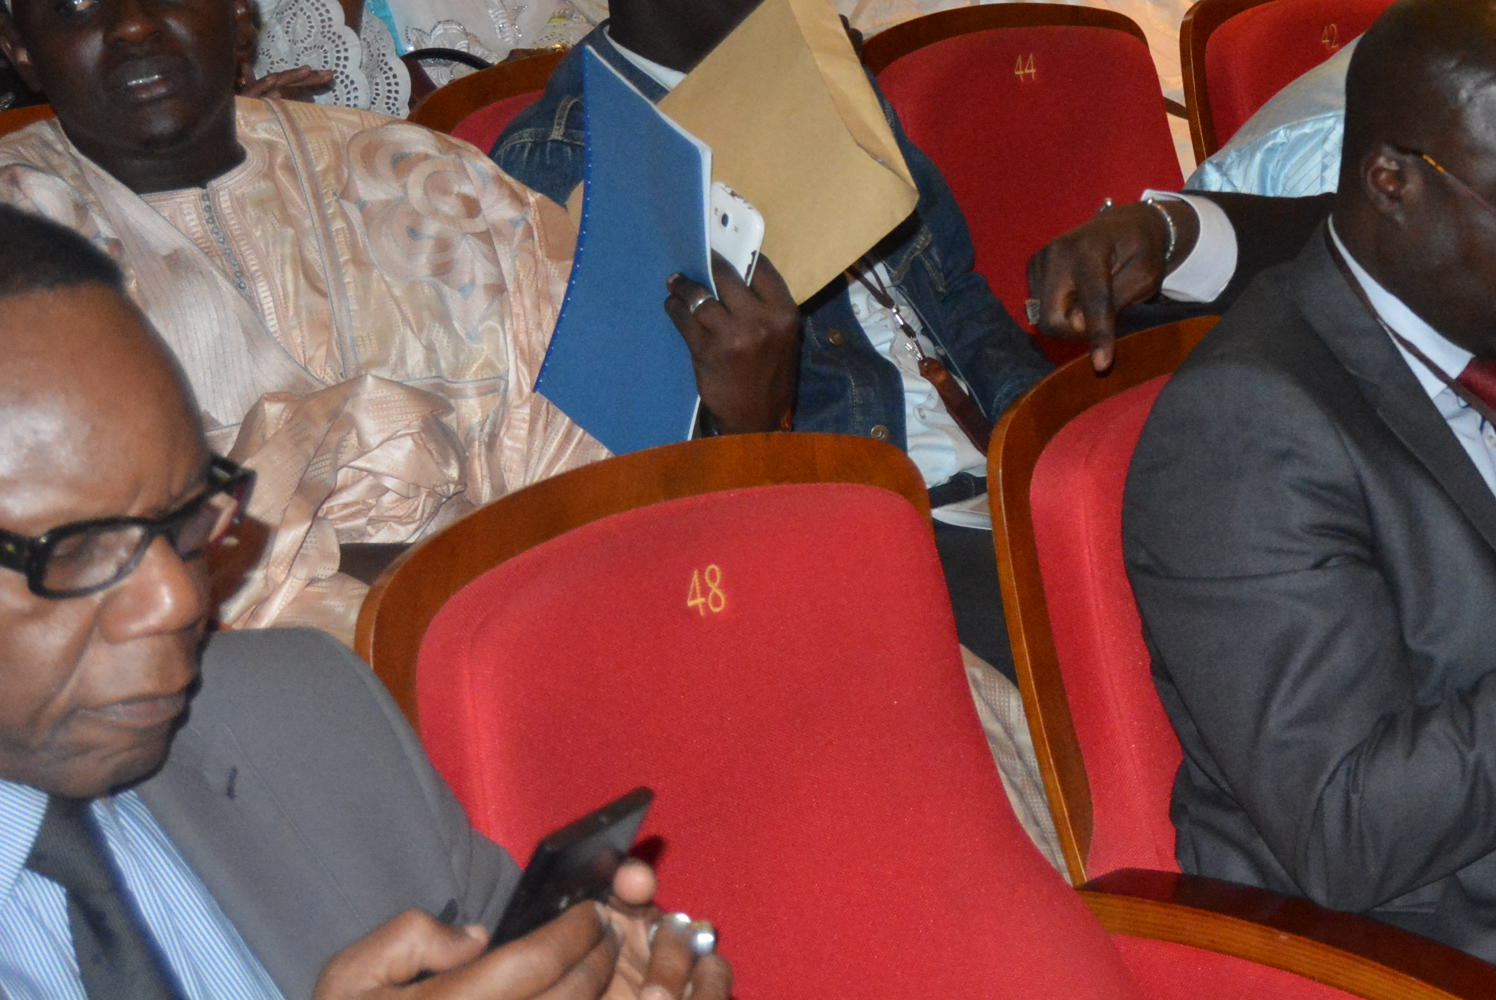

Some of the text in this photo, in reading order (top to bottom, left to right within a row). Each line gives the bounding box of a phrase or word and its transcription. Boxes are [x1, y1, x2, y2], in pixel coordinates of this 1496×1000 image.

[1321, 23, 1339, 48] 42
[1013, 53, 1036, 82] 44
[686, 564, 725, 616] 48
